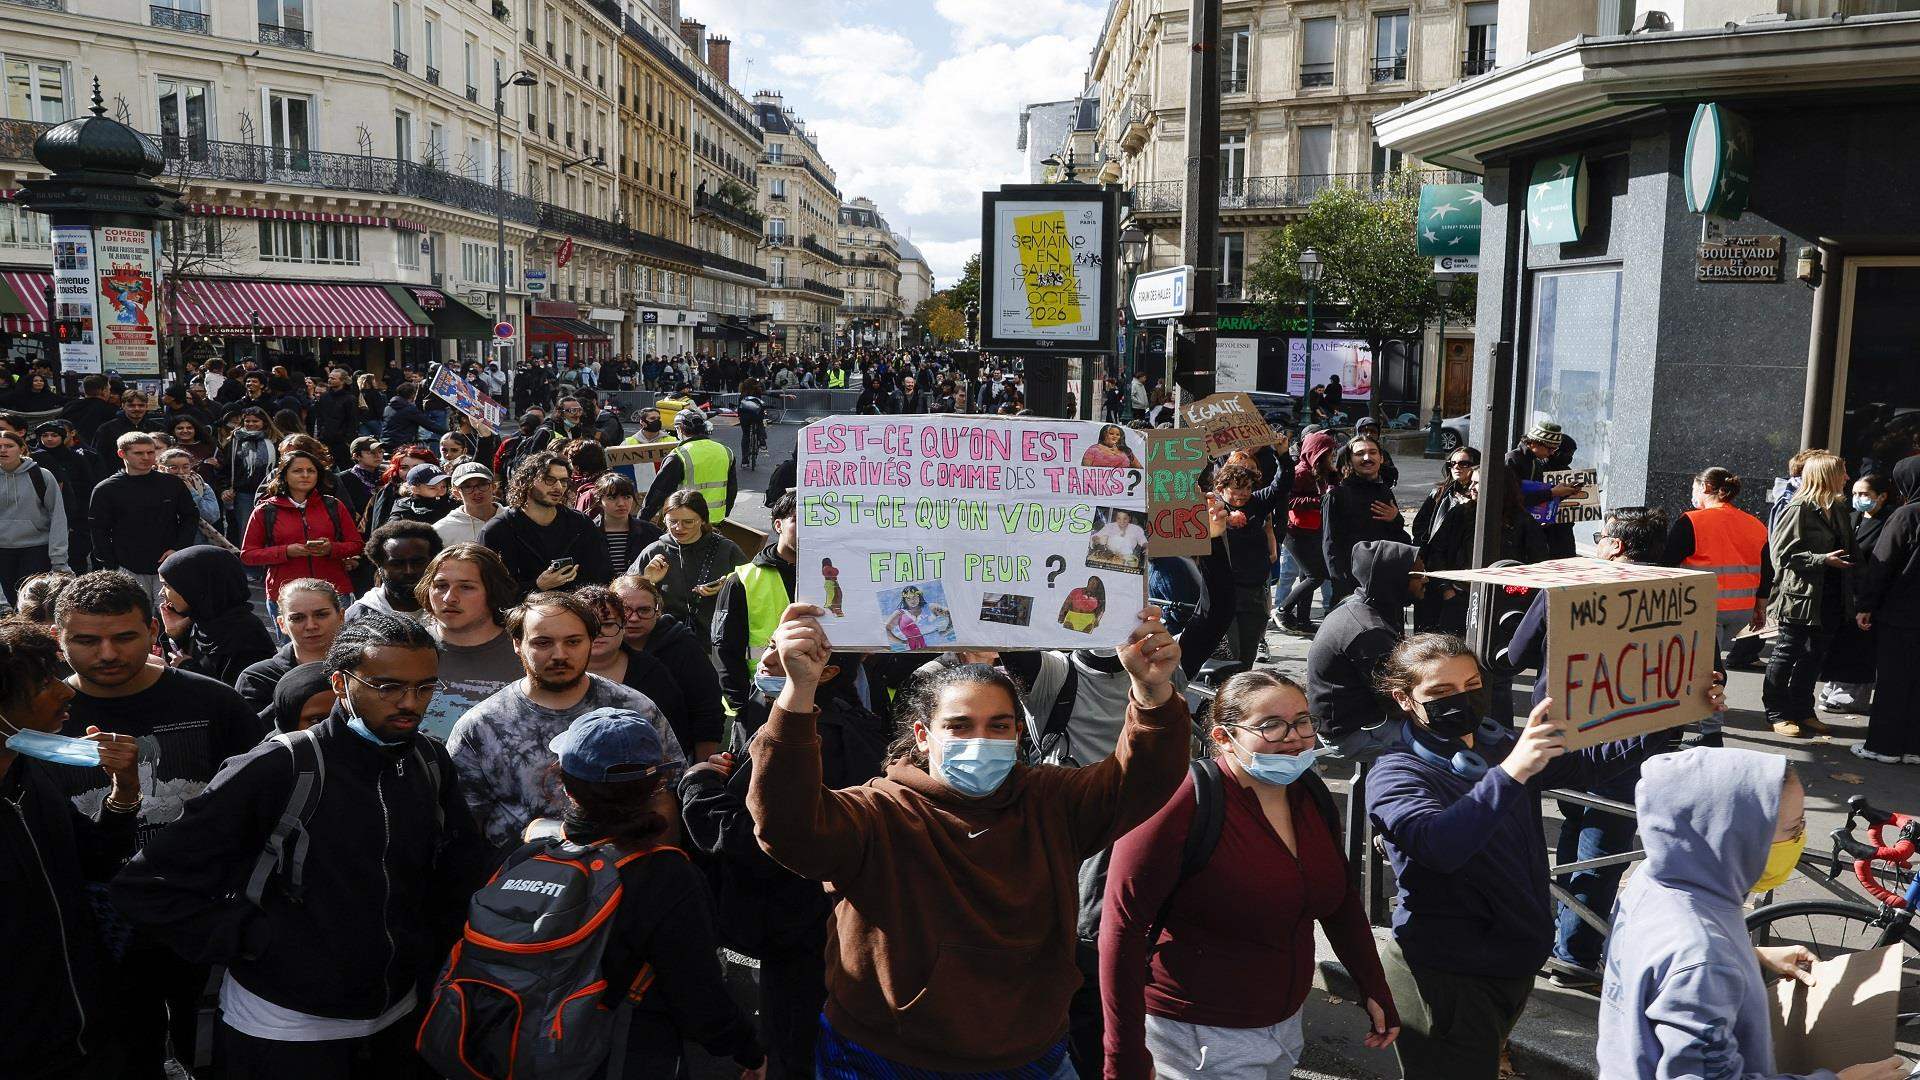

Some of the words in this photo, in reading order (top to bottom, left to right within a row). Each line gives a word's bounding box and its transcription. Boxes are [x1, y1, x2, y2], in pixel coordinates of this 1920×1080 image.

[1031, 220, 1065, 235] UNE
[120, 236, 145, 244] PARIS
[1036, 249, 1060, 263] EN
[1701, 247, 1775, 259] BOULEVARD
[1730, 258, 1744, 266] DE
[1013, 263, 1081, 278] GALERIE
[1698, 264, 1777, 277] SÉBASTOPOL
[1011, 277, 1026, 291] 17
[1062, 278, 1083, 292] 24
[1025, 307, 1067, 321] 2026
[806, 424, 912, 456] EST-CE
[920, 426, 1012, 462] QU'ON
[1022, 430, 1078, 463] EST
[804, 455, 911, 488] ARRIVÉS
[920, 462, 1001, 490] COMME
[1006, 466, 1036, 490] DES
[1044, 466, 1142, 497] TANKS?
[803, 491, 908, 528] EST-CE
[915, 496, 989, 531] QU'ON
[997, 503, 1093, 534] VOUS
[869, 546, 946, 582] FAIT
[964, 553, 1032, 583] PEUR
[1570, 591, 1608, 631] MAIS
[1616, 582, 1698, 632] JAMAIS
[1565, 630, 1698, 721] FACHO!
[500, 879, 567, 898] BASIC-FIT
